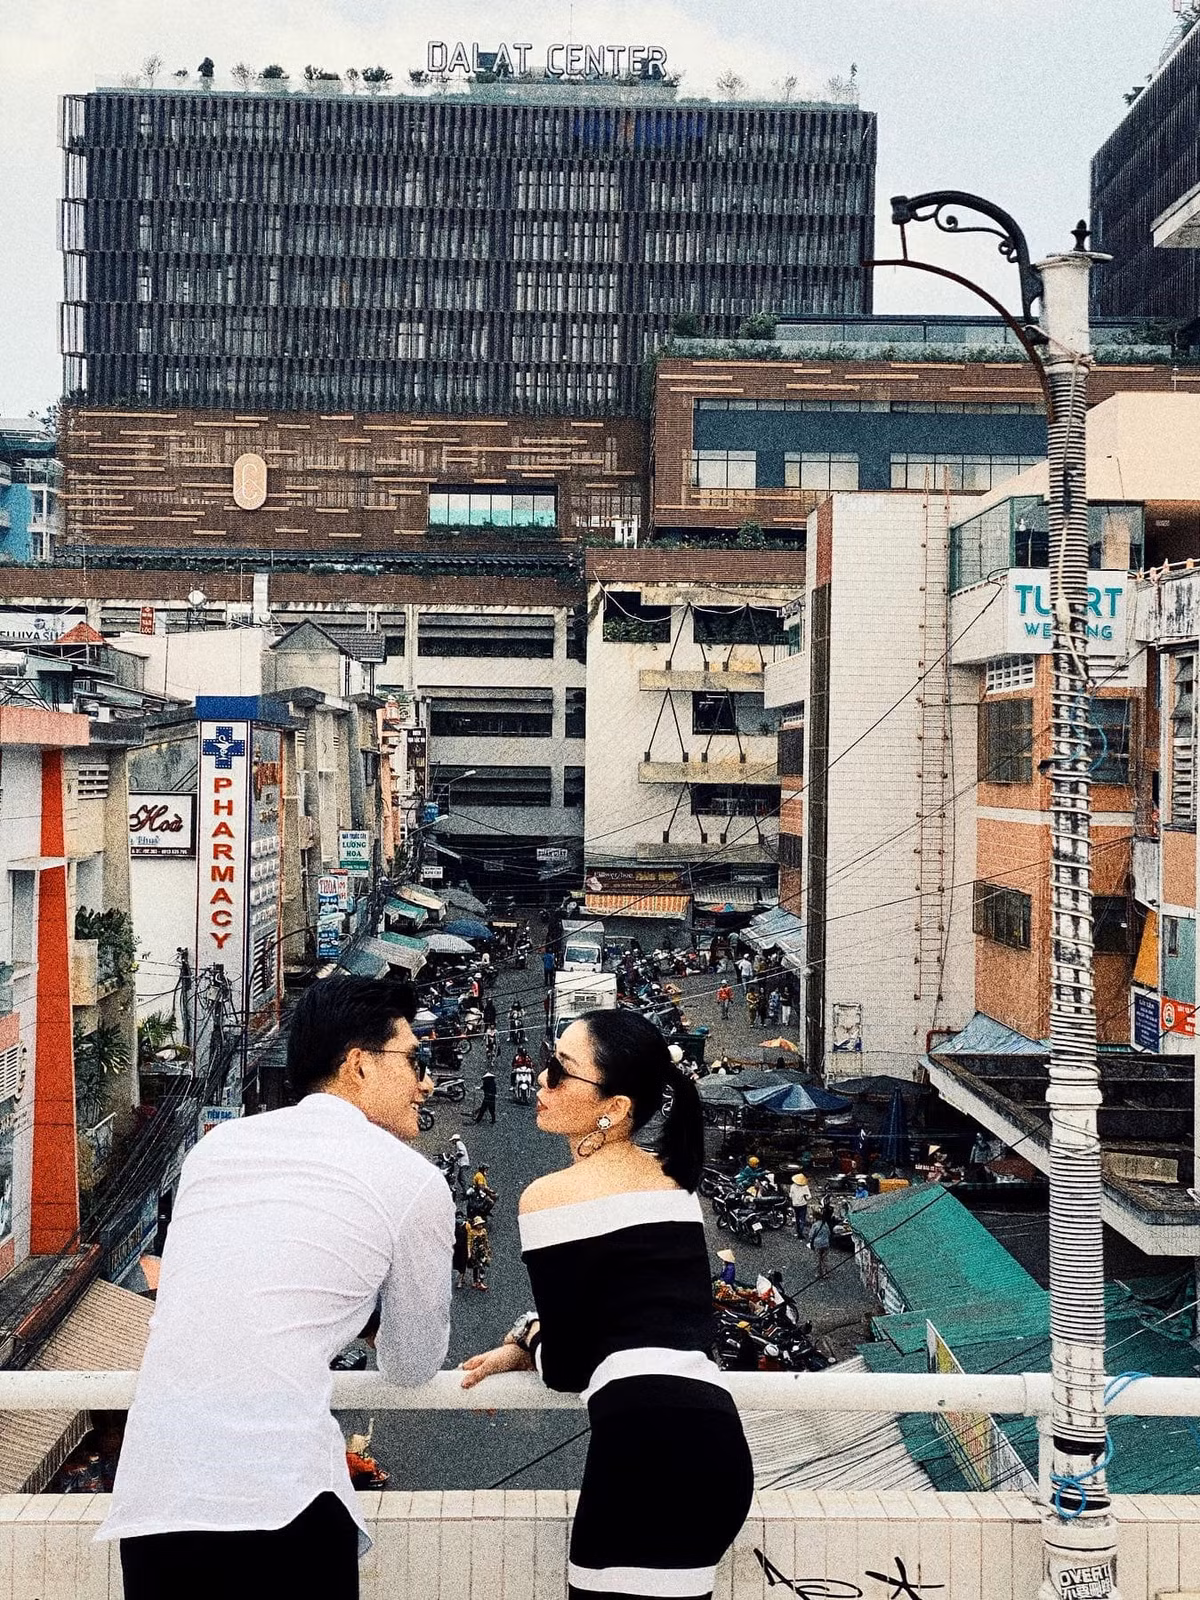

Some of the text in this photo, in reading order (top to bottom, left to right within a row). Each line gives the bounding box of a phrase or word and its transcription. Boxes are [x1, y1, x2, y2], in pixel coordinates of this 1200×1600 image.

[427, 41, 668, 77] DALAT CENTER
[1014, 584, 1123, 618] TURT
[1024, 622, 1113, 640] WENG
[210, 777, 235, 950] PHARMACY
